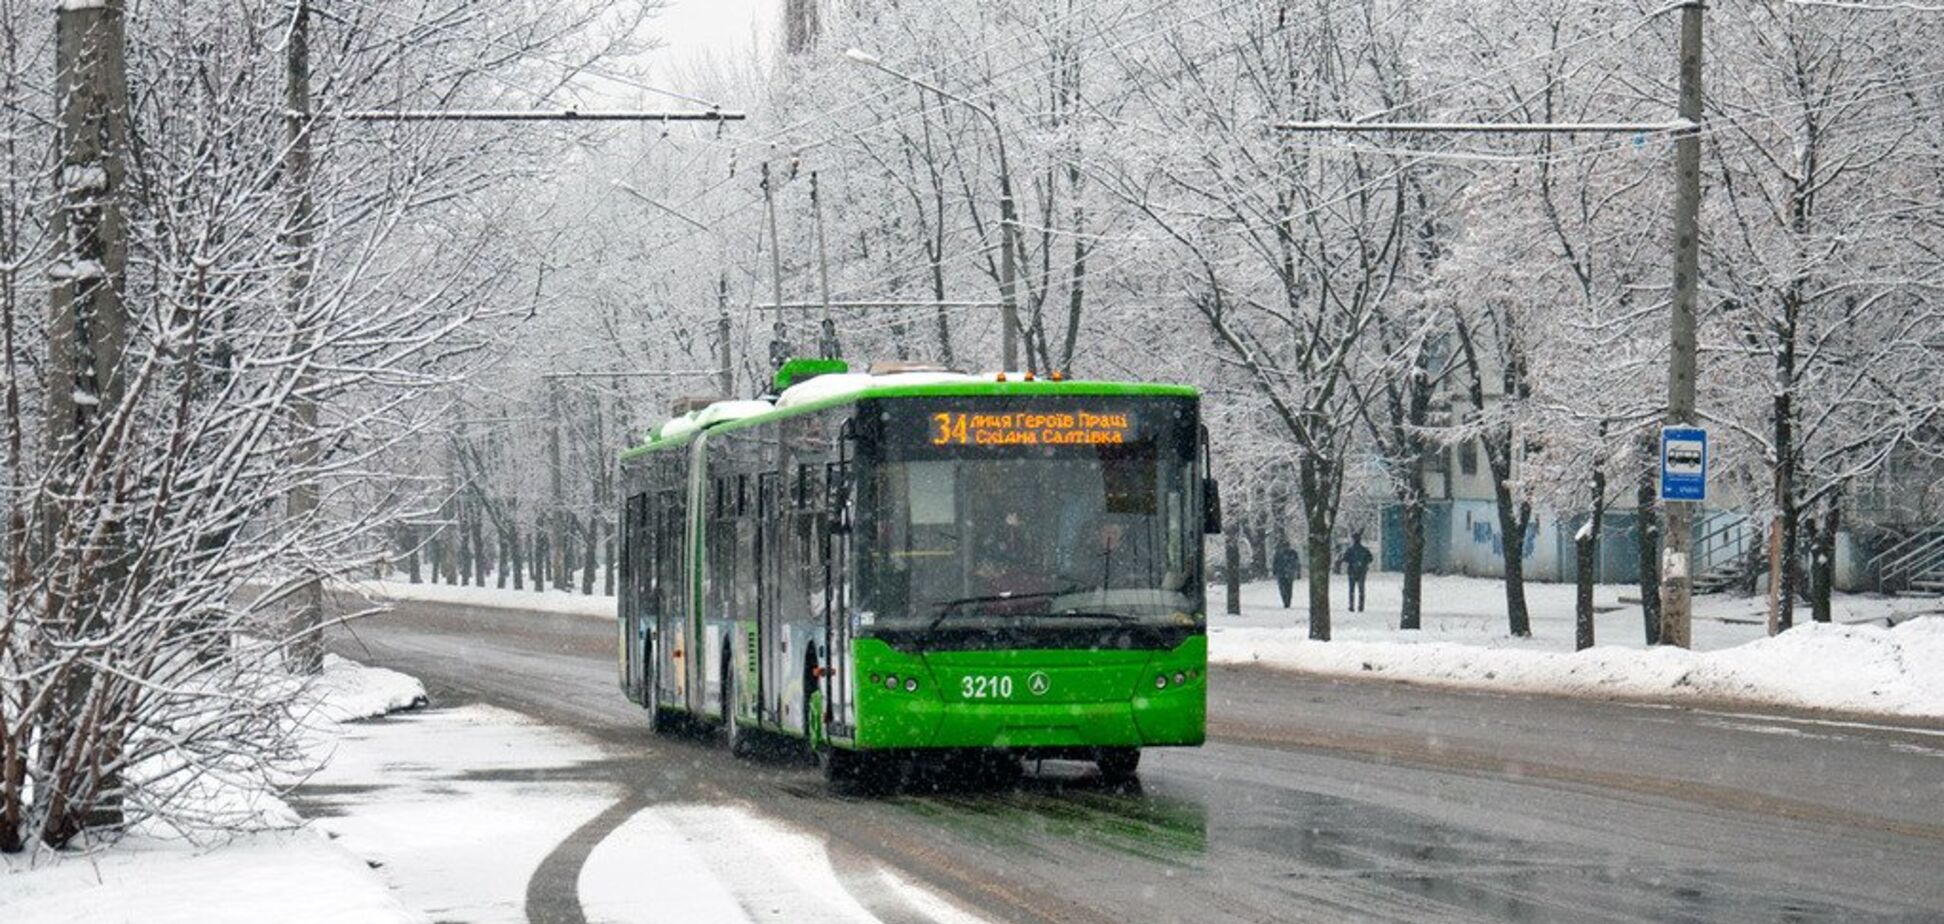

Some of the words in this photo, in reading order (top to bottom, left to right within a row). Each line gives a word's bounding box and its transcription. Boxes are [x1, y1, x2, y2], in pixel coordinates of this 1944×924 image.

[933, 412, 967, 445] 34
[1016, 412, 1074, 429] Героїв
[1078, 411, 1128, 429] Праці
[975, 429, 1037, 444] Східна
[1042, 429, 1123, 444] Салтівка
[962, 676, 1012, 698] 3210
